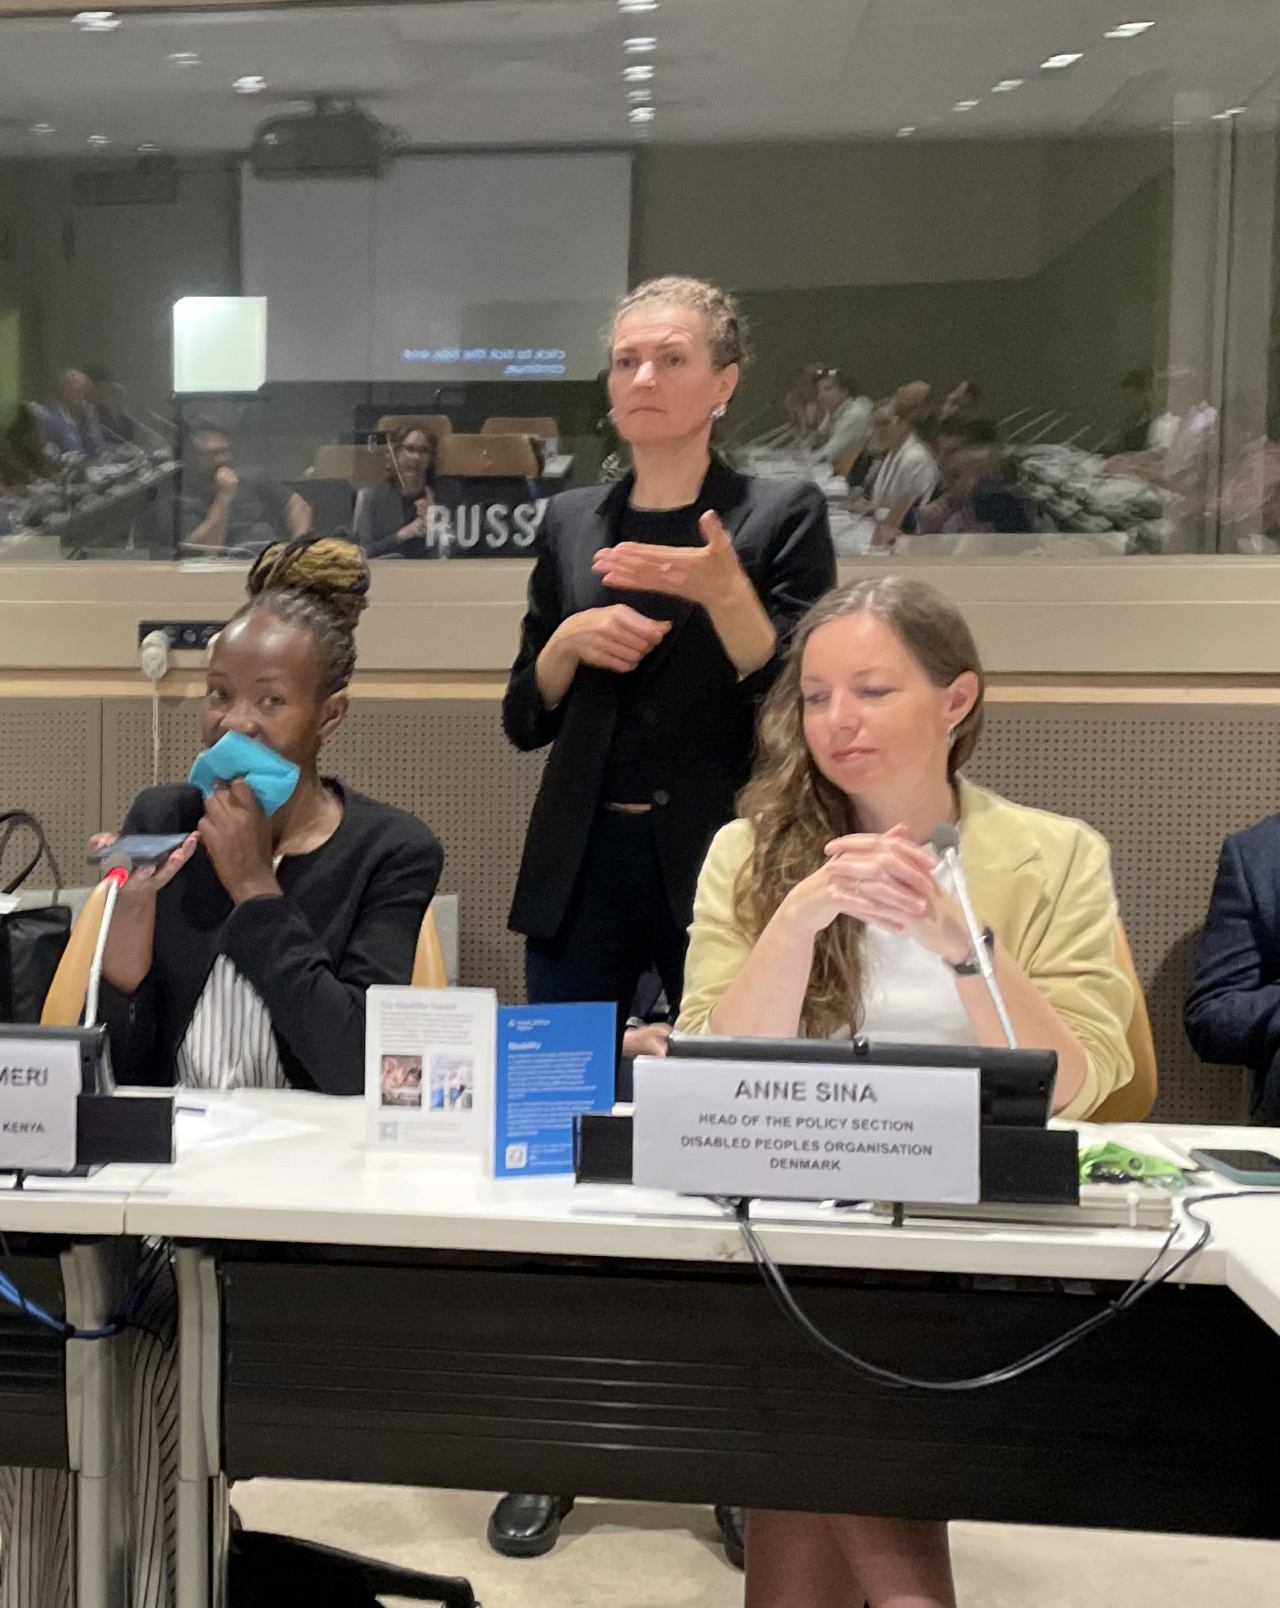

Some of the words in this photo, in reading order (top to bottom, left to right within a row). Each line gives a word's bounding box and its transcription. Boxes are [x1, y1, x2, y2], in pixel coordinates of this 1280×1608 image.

[425, 503, 536, 548] RUSS
[735, 1080, 807, 1101] ANNE
[816, 1083, 878, 1104] SINA
[2, 1122, 46, 1133] KENYA
[699, 1113, 737, 1125] HEAD
[741, 1115, 761, 1127] OF
[765, 1116, 792, 1128] THE
[795, 1117, 847, 1130] POLICY
[851, 1118, 914, 1132] SECTION
[681, 1135, 751, 1149] DISABLED
[755, 1138, 820, 1152] PEOPLES
[824, 1140, 933, 1156] ORGANISATION
[770, 1157, 841, 1171] DENMARK
